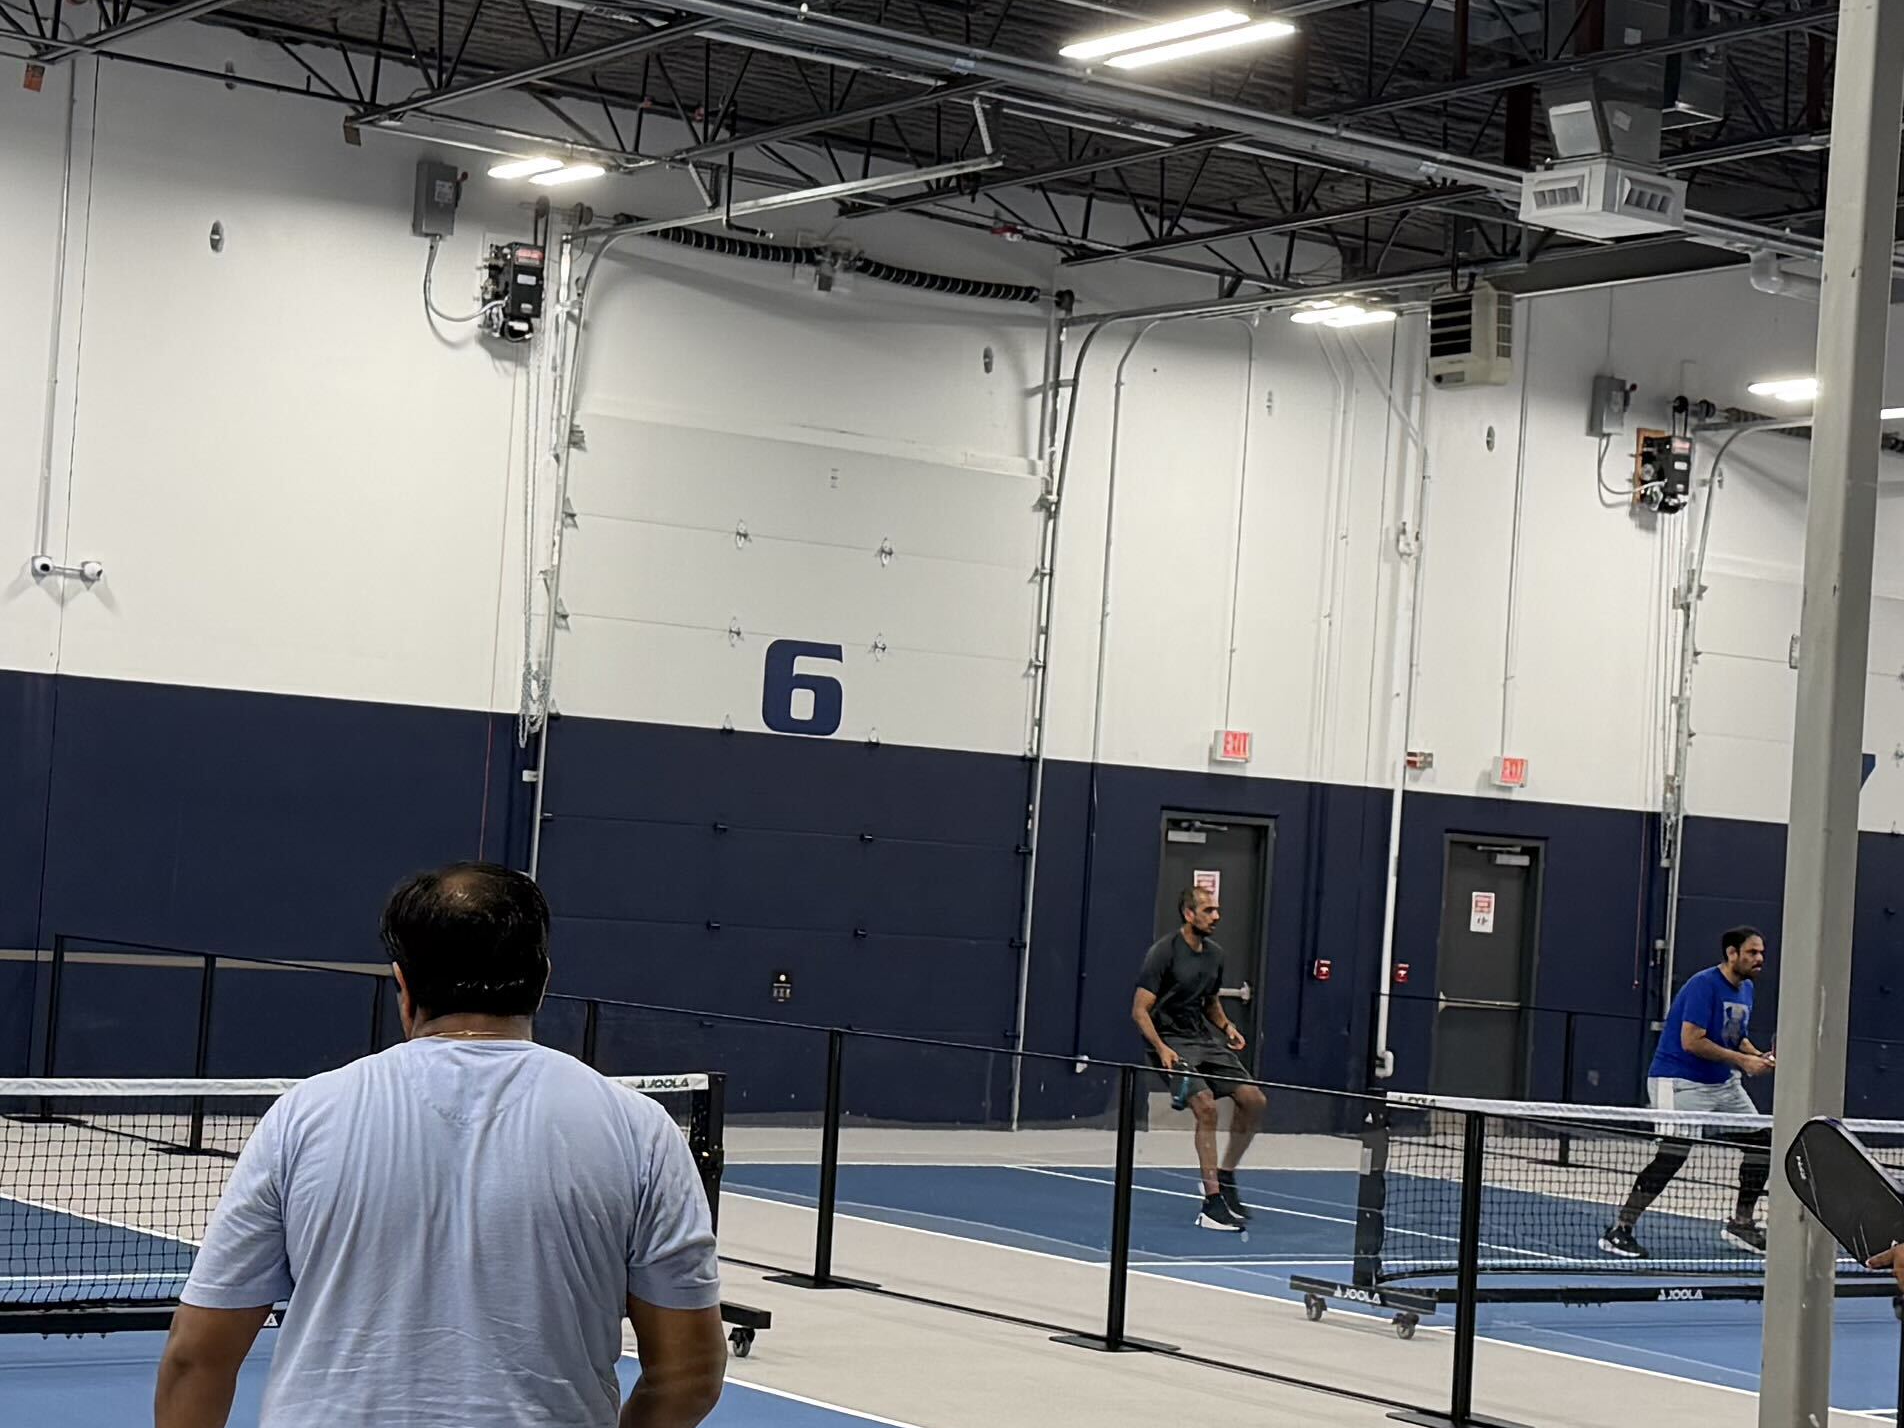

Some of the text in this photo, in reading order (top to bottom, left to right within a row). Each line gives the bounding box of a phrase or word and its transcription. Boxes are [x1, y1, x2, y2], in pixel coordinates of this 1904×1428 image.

[762, 639, 843, 736] 6
[648, 1078, 689, 1089] JOOLA
[1343, 1287, 1382, 1305] JOOLA
[1667, 1289, 1704, 1300] JOOLA
